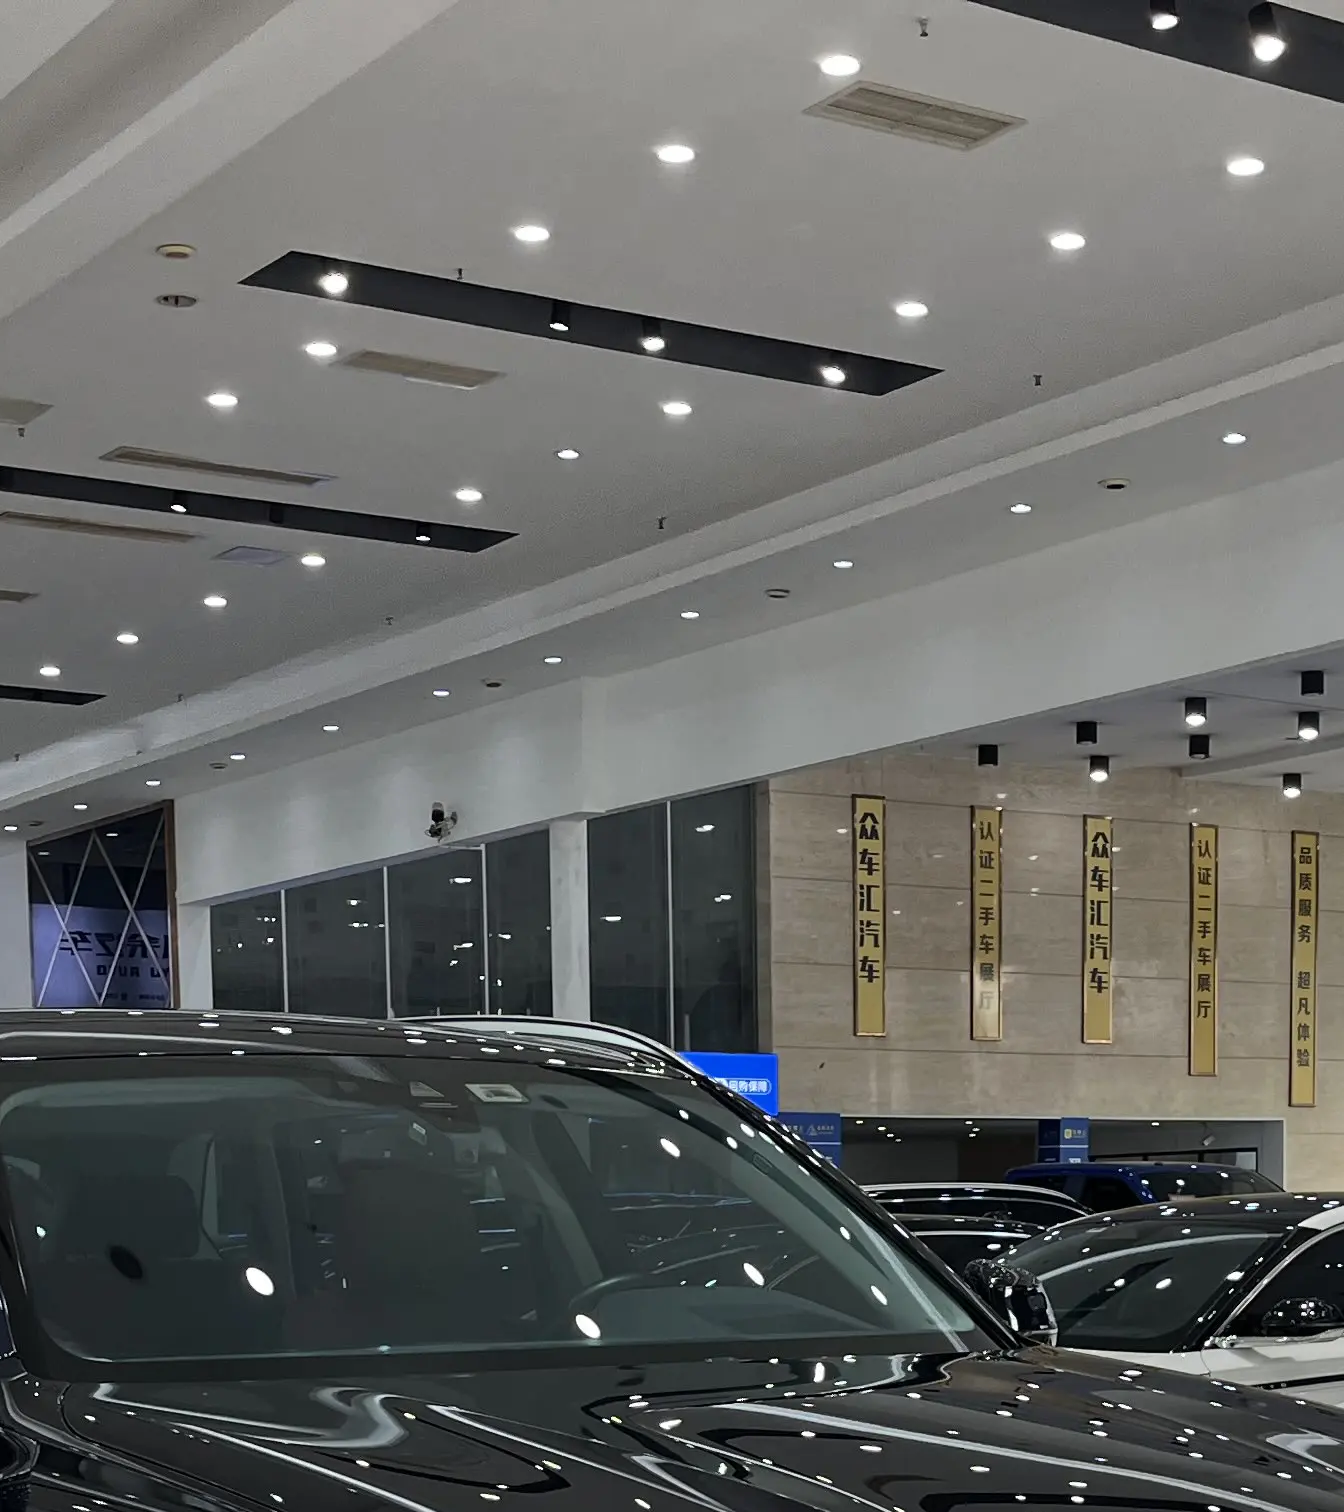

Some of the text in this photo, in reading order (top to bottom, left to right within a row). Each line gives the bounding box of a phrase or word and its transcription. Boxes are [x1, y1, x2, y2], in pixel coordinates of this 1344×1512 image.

[858, 811, 881, 984] 众车汇汽车
[978, 820, 996, 1011] 认证二手车展厅
[1088, 831, 1111, 994] 众车汇汽车
[1196, 839, 1213, 1020] 认证二手车展厅
[1296, 846, 1313, 1068] 品质服务 超凡体验
